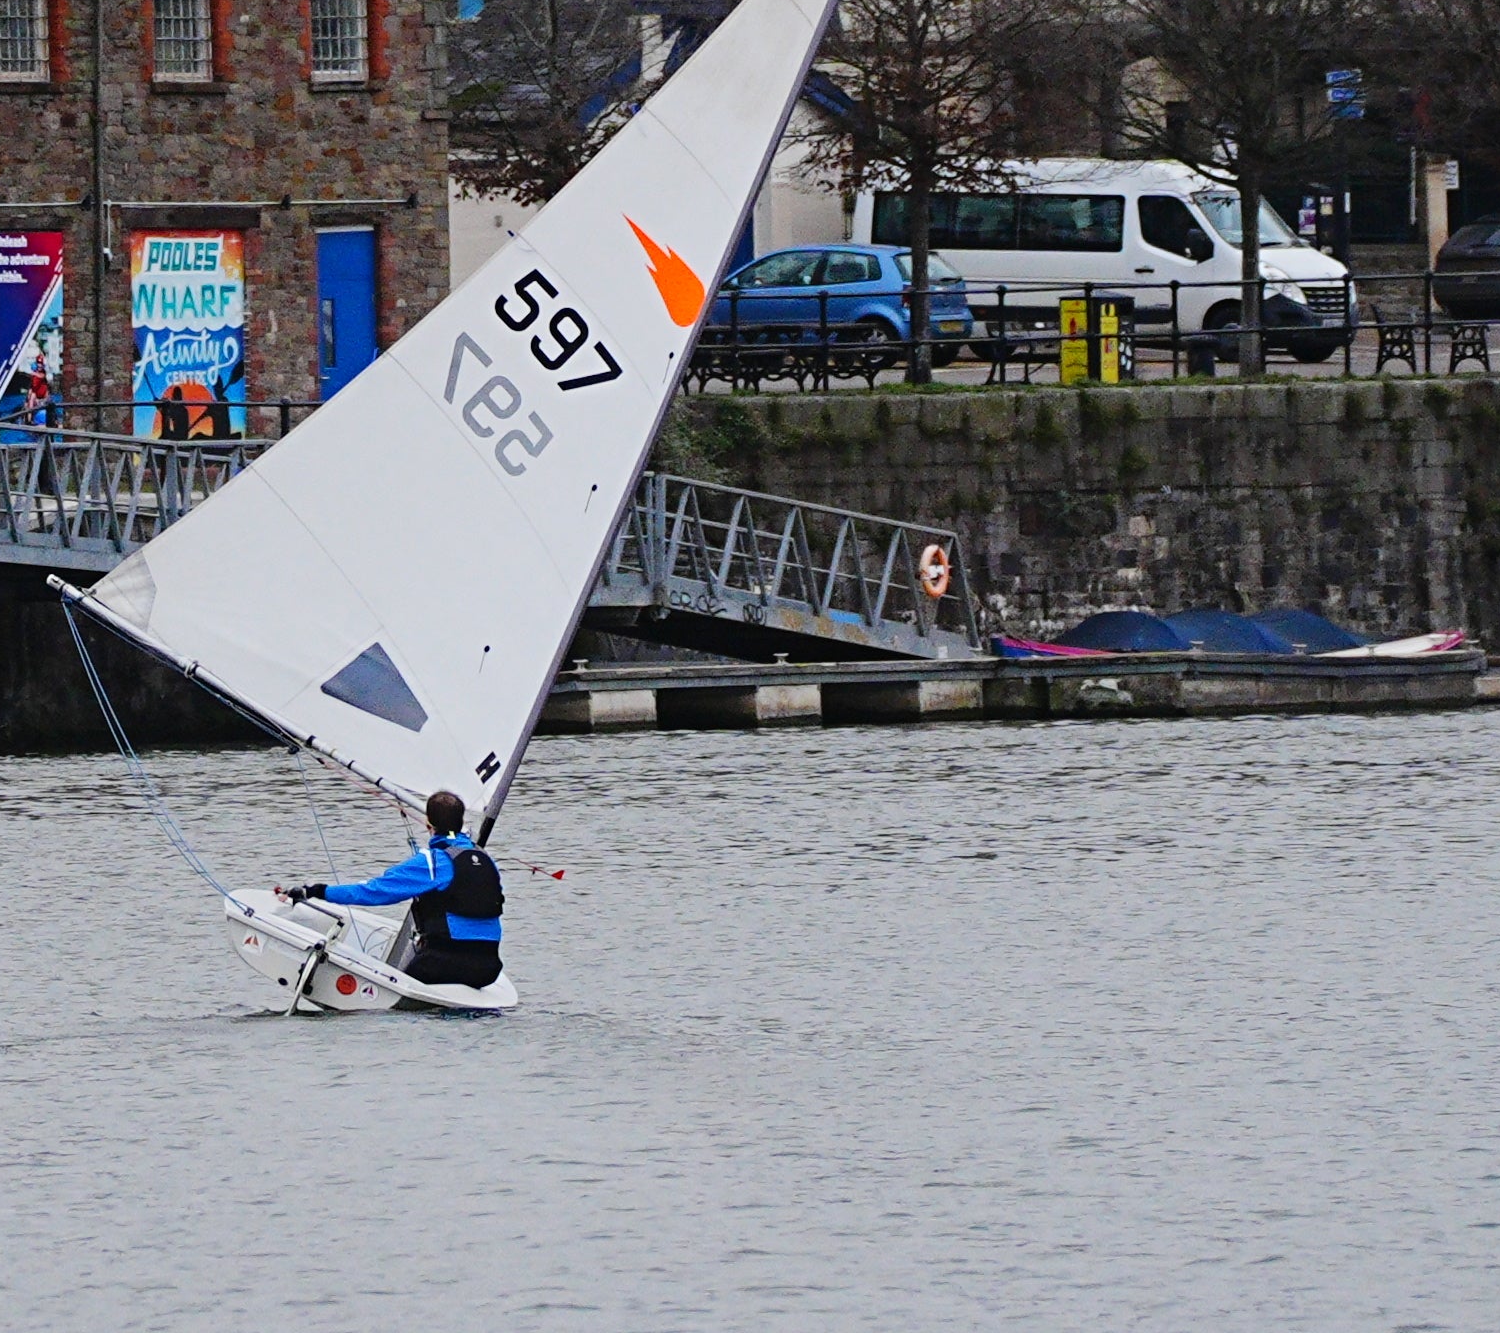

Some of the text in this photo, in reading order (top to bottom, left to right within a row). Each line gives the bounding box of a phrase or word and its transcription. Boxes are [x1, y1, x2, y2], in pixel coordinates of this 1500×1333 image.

[10, 252, 50, 266] adventure
[146, 241, 219, 272] POOLES
[132, 283, 237, 319] WHARF
[494, 268, 623, 392] 597
[132, 328, 240, 394] Activity
[165, 369, 208, 387] CENTRE
